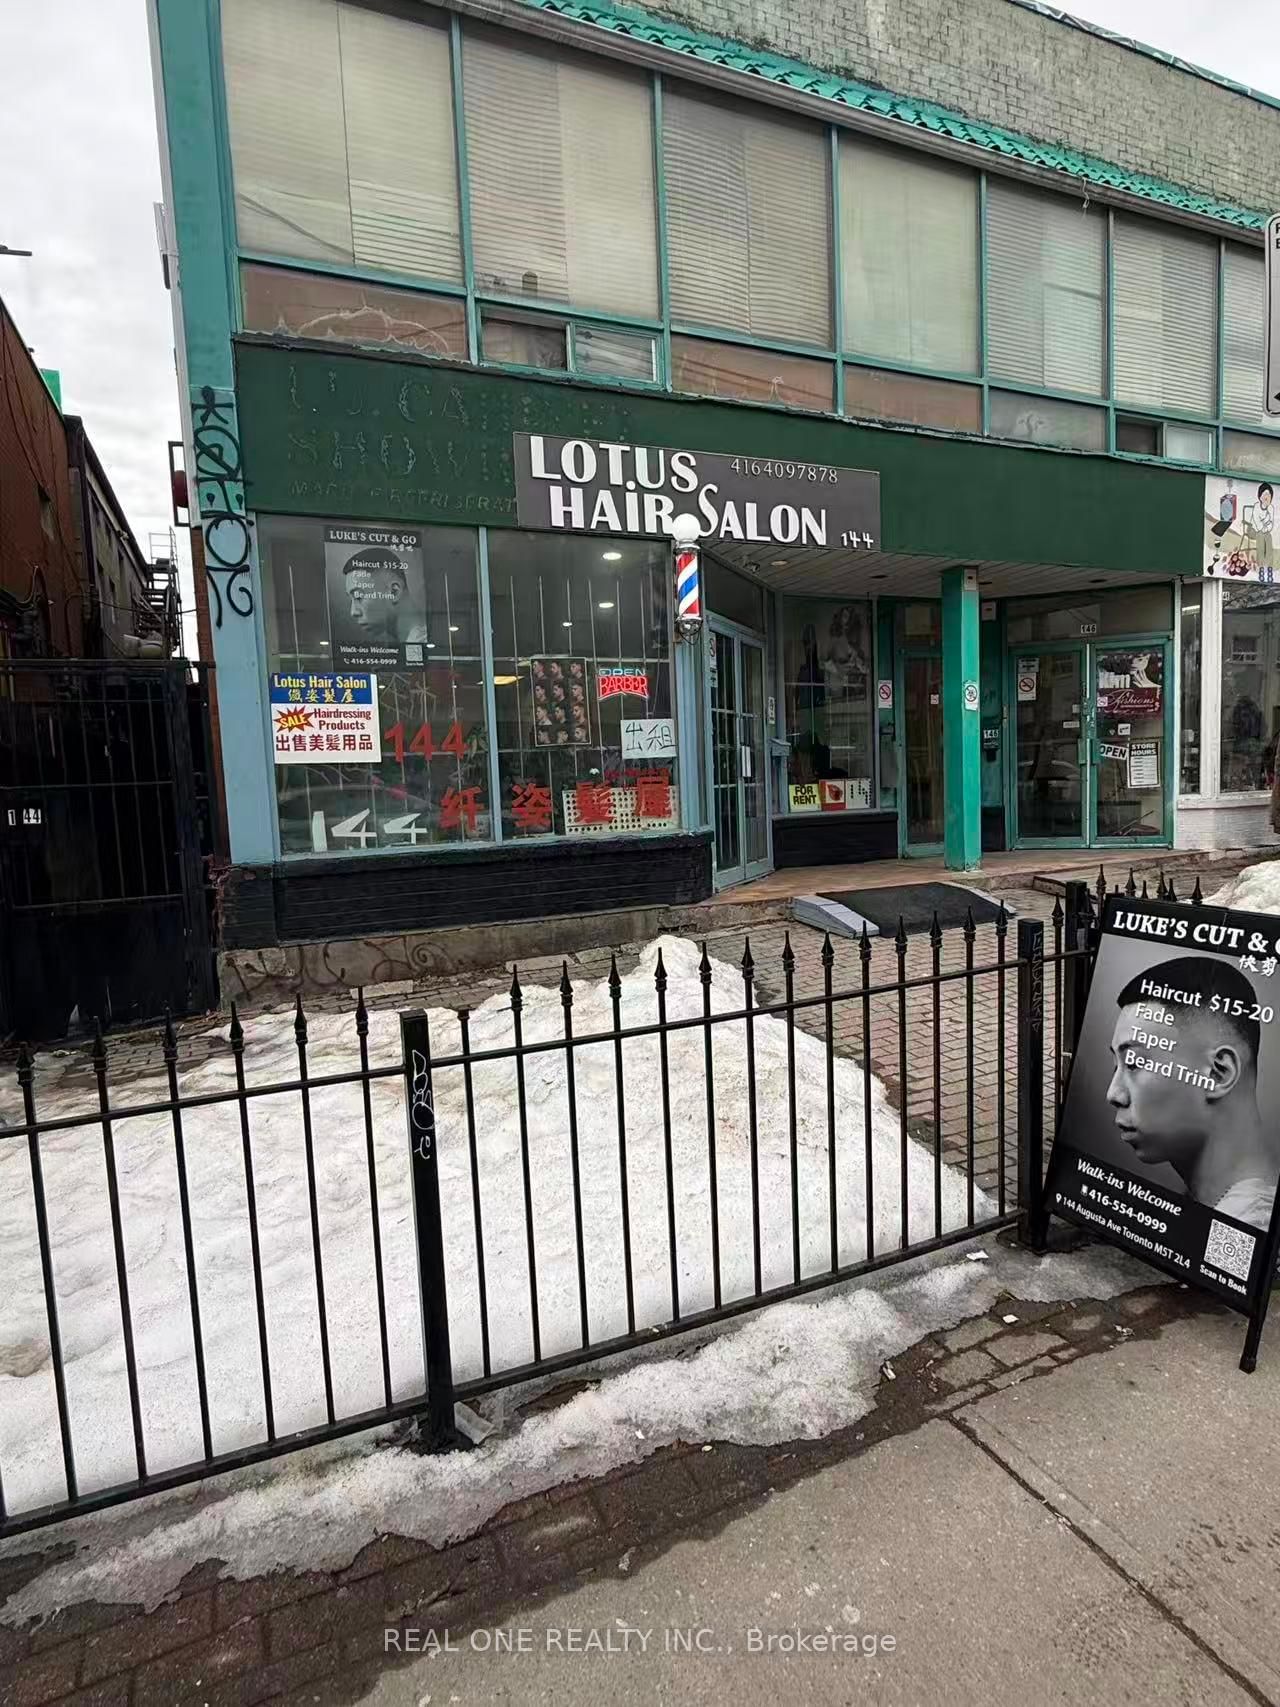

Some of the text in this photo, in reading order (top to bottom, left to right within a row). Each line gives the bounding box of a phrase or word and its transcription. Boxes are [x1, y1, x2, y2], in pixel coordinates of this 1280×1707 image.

[530, 436, 699, 492] LOTUS
[730, 458, 839, 484] 4164097878
[698, 484, 827, 546] SALON
[329, 530, 417, 545] LUKE'S CUT & GO
[841, 531, 875, 549] 144
[352, 560, 408, 570] Haircut $15-20
[1081, 624, 1097, 634] 146
[274, 675, 367, 689] Lotus Hair Salon
[599, 668, 646, 676] OPEN
[598, 675, 649, 698] BARBER
[280, 715, 308, 729] SALE
[313, 708, 372, 721] Hairdressing
[318, 720, 366, 731] Products
[276, 733, 373, 752] 出售美髮用品
[384, 722, 469, 763] 144
[625, 721, 677, 751] 出租
[1100, 745, 1127, 759] OPEN
[793, 795, 817, 805] RENT
[794, 785, 813, 795] FOR
[312, 808, 428, 853] 144
[1113, 910, 1189, 940] LUKE'S
[1192, 923, 1245, 949] CUT
[1247, 931, 1269, 953] &
[1139, 978, 1275, 1024] Haircut $15-20
[1135, 1002, 1176, 1027] Fade
[1130, 1025, 1177, 1052] Taper
[1124, 1049, 1217, 1092] Beard Trim
[1077, 1158, 1183, 1216] Walk-ins Welcome
[1088, 1189, 1168, 1234] 416-554-0999
[1063, 1197, 1191, 1269] 144 Augusta Ave Toronto M5T 2L4
[1199, 1264, 1248, 1296] Scan to Book
